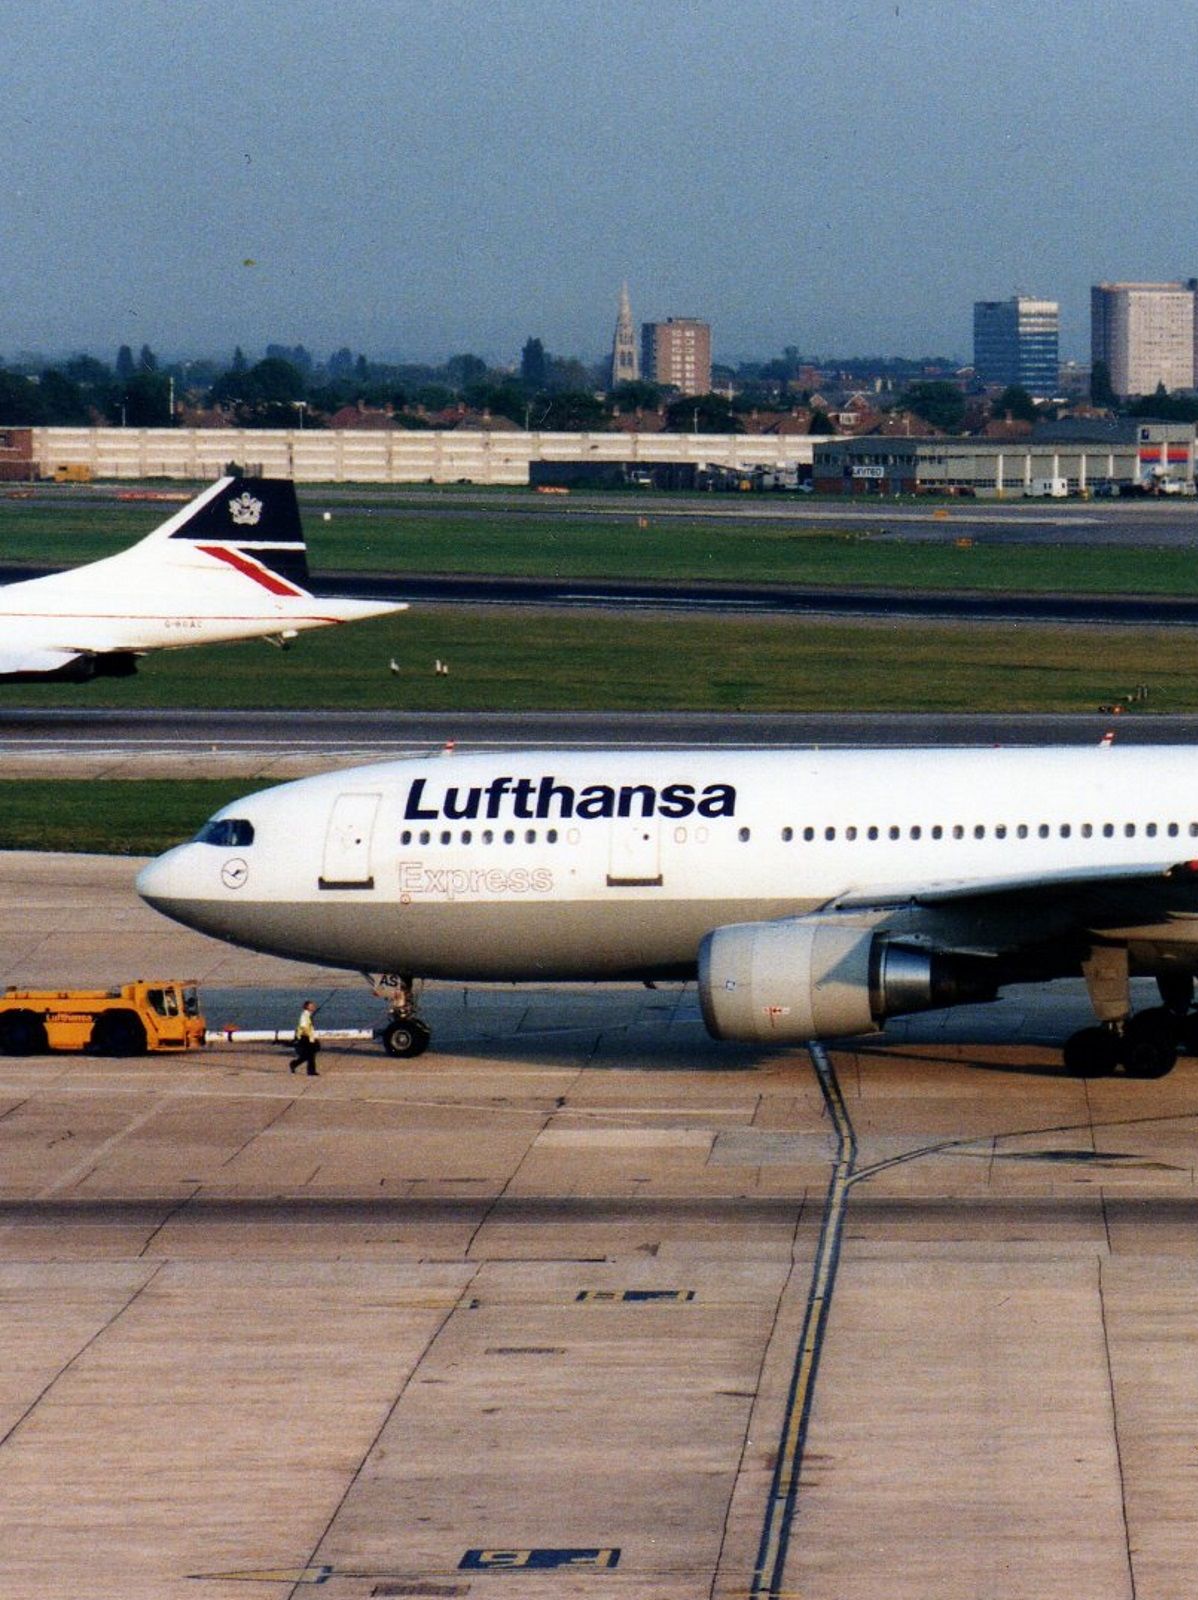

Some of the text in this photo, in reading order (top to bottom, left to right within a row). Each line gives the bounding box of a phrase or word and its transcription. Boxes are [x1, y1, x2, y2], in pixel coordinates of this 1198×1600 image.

[404, 776, 736, 820] Lufthansa
[399, 861, 553, 900] Express
[380, 974, 399, 987] AS
